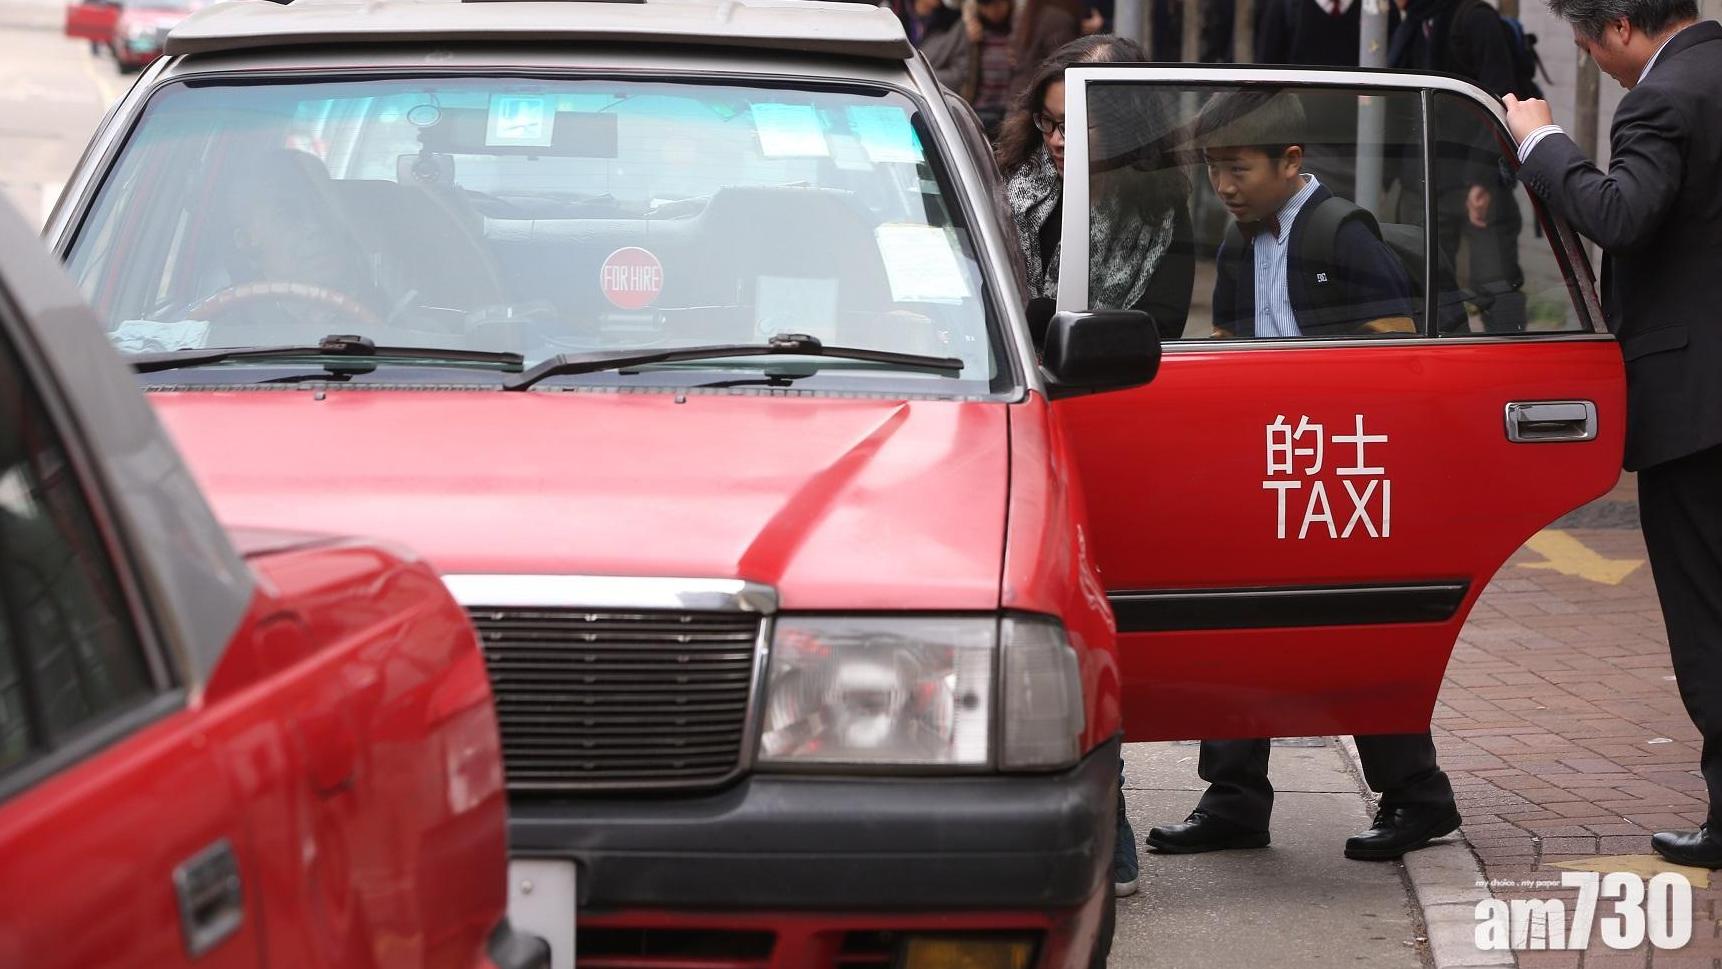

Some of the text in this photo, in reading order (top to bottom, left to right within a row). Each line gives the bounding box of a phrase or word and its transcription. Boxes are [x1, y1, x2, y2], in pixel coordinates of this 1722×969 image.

[604, 265, 660, 291] FOR HIRE
[1266, 414, 1388, 476] 的士
[1262, 479, 1391, 539] TAXI
